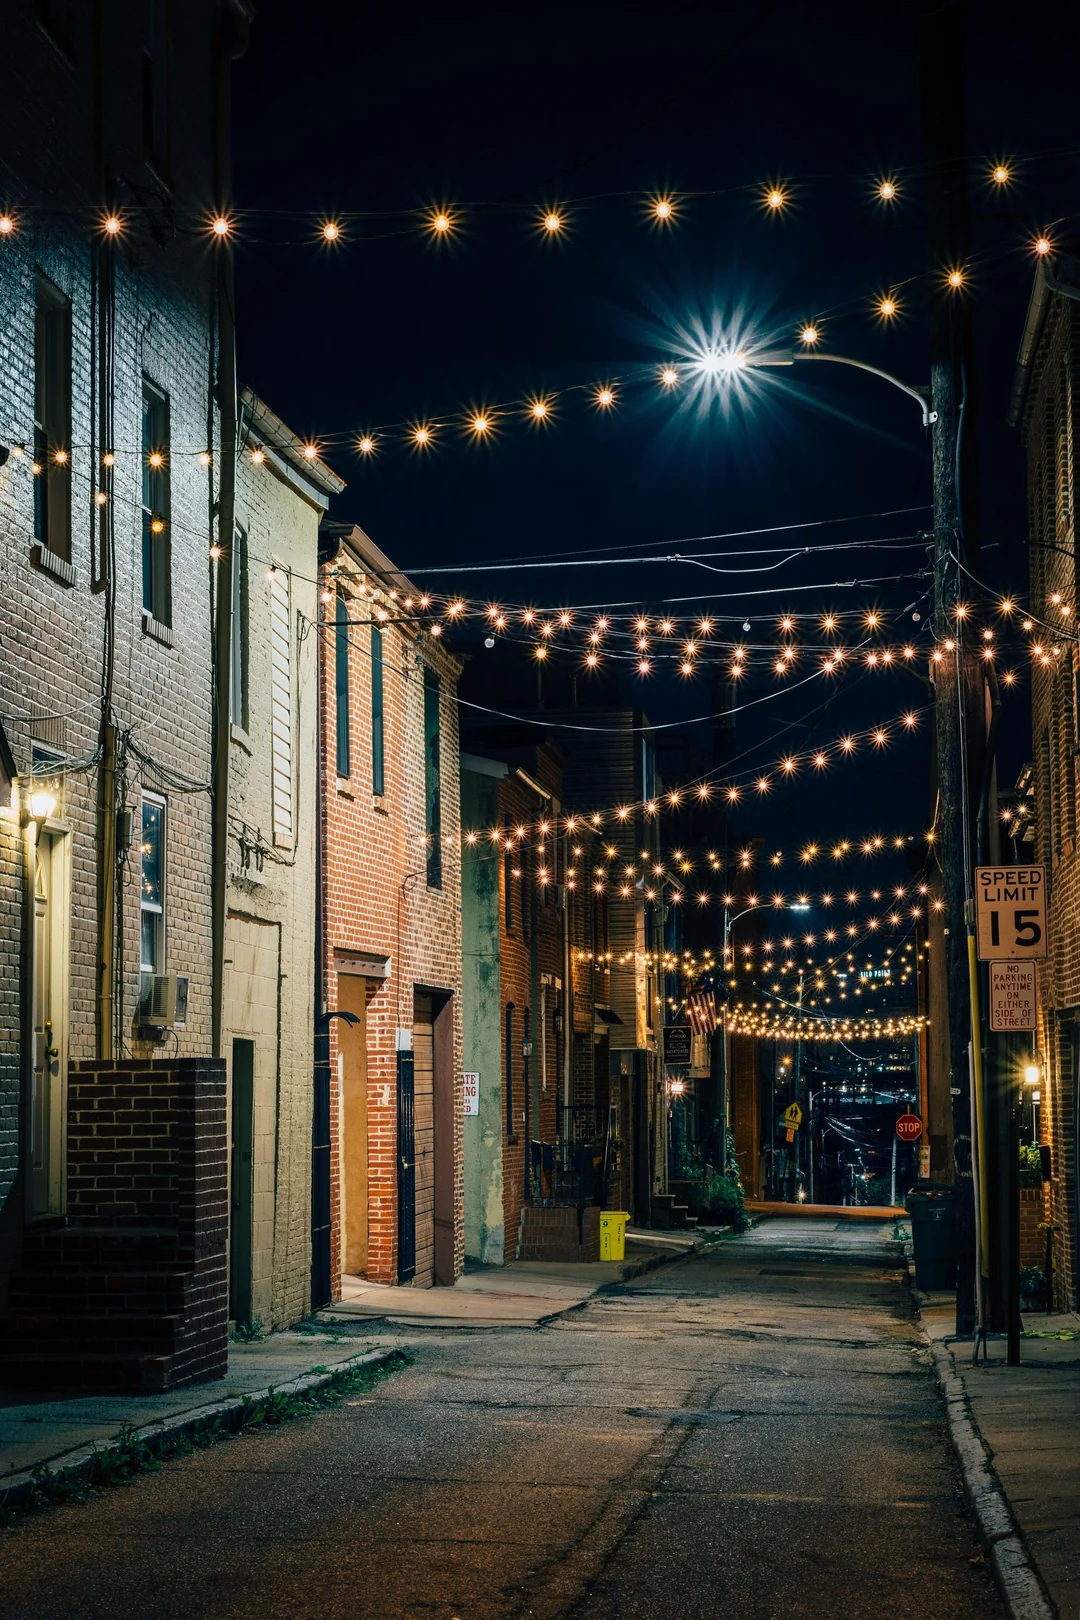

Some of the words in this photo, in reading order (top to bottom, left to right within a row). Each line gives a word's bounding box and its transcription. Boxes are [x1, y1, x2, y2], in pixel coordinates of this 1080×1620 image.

[981, 871, 1041, 886] SPEED
[985, 887, 1038, 902] LIMIT
[991, 910, 1041, 947] 15
[1007, 965, 1019, 973] NO
[994, 974, 1032, 982] PARKING
[998, 1000, 1030, 1008] EITHER
[995, 1009, 1015, 1018] SIDE
[1022, 1009, 1032, 1017] OF
[997, 1018, 1031, 1026] STREET
[898, 1122, 920, 1133] STOP
